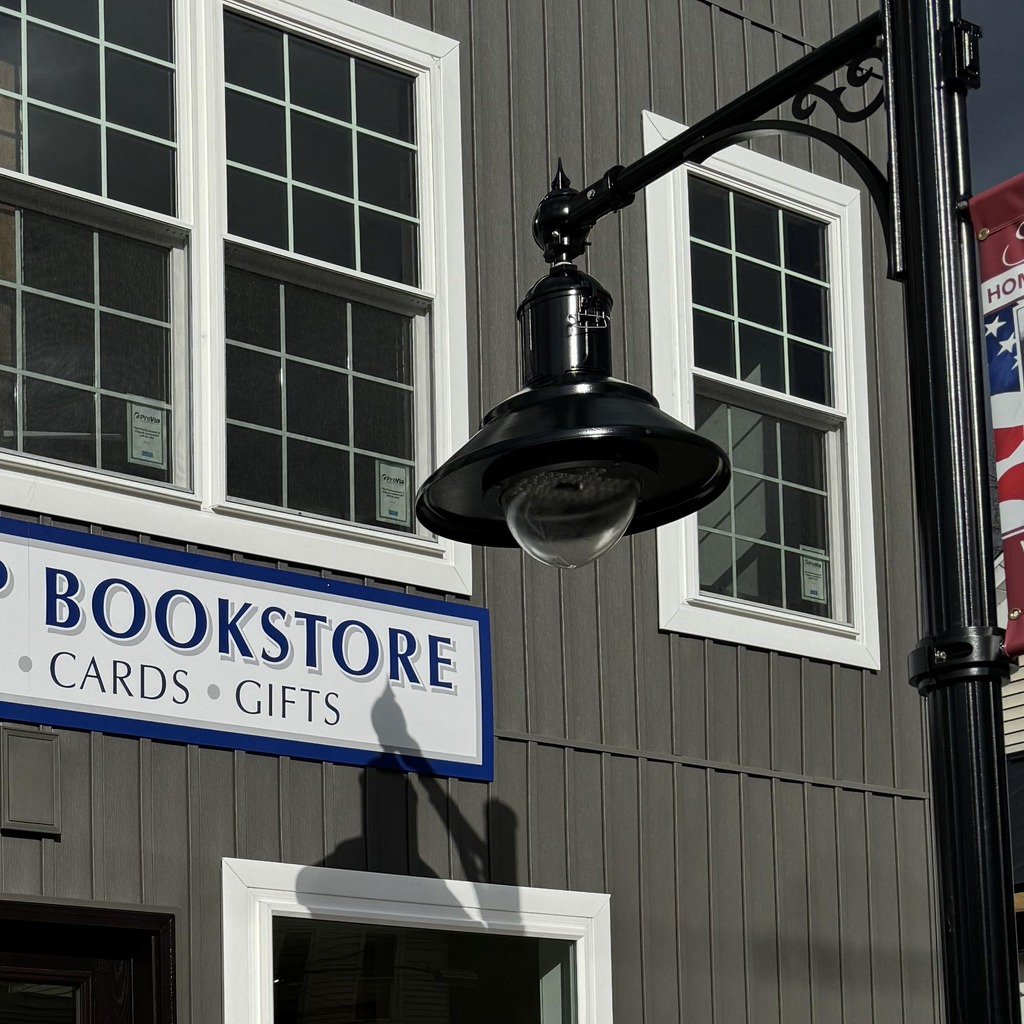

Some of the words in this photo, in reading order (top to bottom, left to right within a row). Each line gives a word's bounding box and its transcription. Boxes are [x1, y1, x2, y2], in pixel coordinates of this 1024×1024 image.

[44, 566, 457, 692] BOOKSTORE
[49, 651, 191, 705] CARDS
[235, 680, 341, 726] GIFTS
